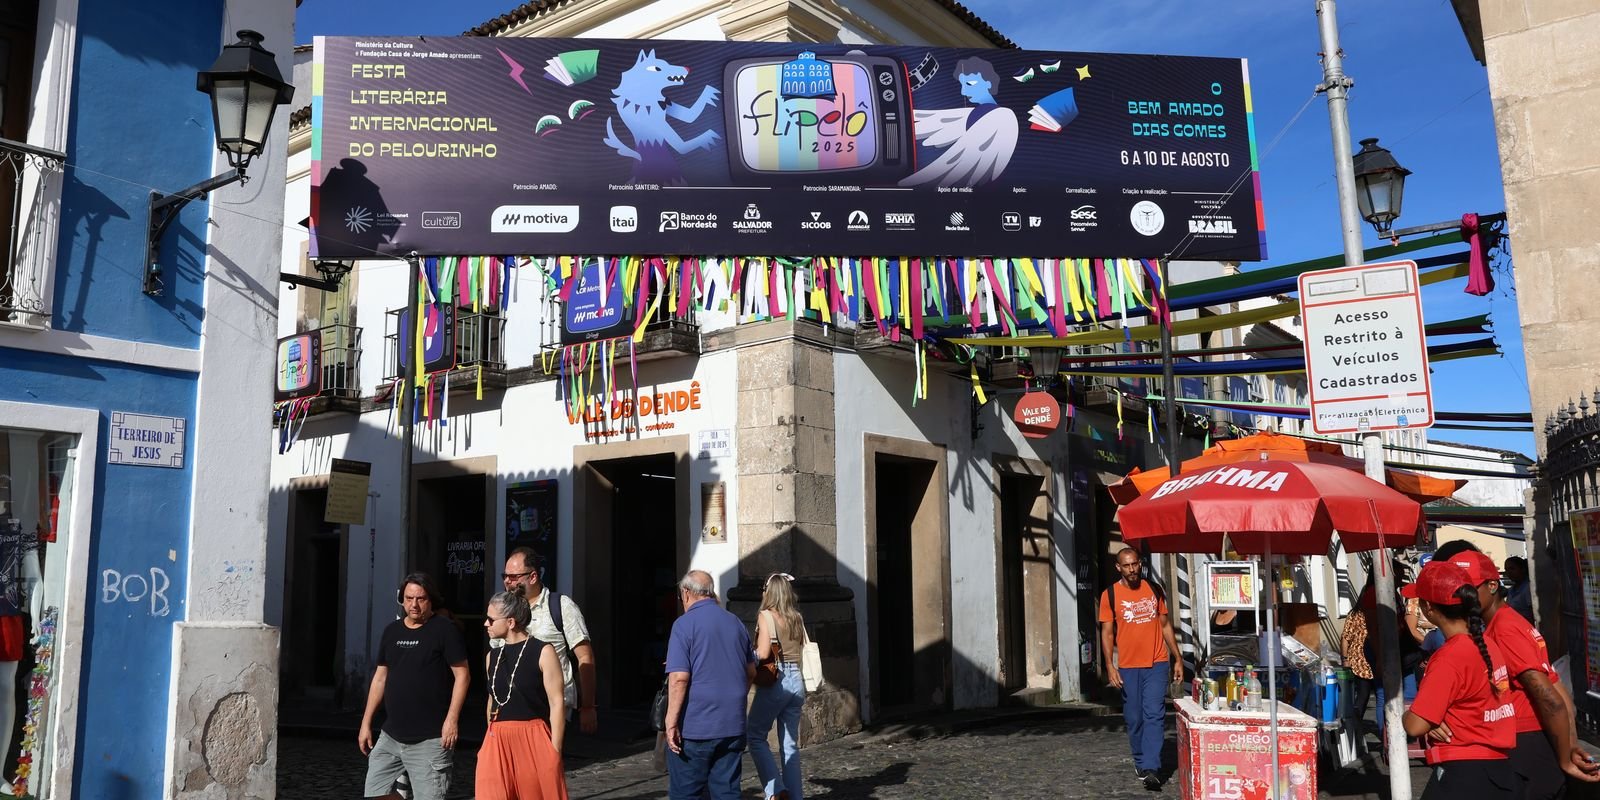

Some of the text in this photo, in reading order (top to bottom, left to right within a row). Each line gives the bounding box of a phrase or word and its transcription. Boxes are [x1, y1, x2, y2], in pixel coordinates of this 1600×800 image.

[352, 64, 406, 78] FESTA
[1211, 82, 1222, 95] O
[351, 88, 447, 105] LITERÁRIA
[1128, 101, 1224, 117] BEM AMADO
[350, 116, 498, 132] INTERNACIONAL
[1132, 123, 1227, 138] DIAS GOMES
[350, 143, 497, 158] DO PELOURINHO
[812, 141, 854, 153] 2025
[1120, 150, 1230, 168] 6 A 10 DE AGOSTO
[424, 218, 458, 226] cultura
[523, 213, 568, 224] motiva
[612, 217, 635, 227] itaú
[680, 213, 717, 221] Banco do
[680, 221, 718, 229] Nordeste
[732, 221, 772, 229] SALVADOR
[1188, 220, 1237, 234] BRASIL
[586, 307, 614, 320] moiva
[1334, 310, 1389, 325] Acesso
[1324, 326, 1403, 346] Restrito à
[1332, 351, 1400, 367] Veículos
[1319, 372, 1418, 390] Cadastrados
[640, 381, 701, 416] DENDÊ
[1021, 406, 1051, 417] VALE DO
[117, 427, 176, 445] TERREIRO DE
[131, 446, 161, 460] JESUS
[1150, 466, 1289, 500] BRAHMA
[103, 567, 170, 617] BOB
